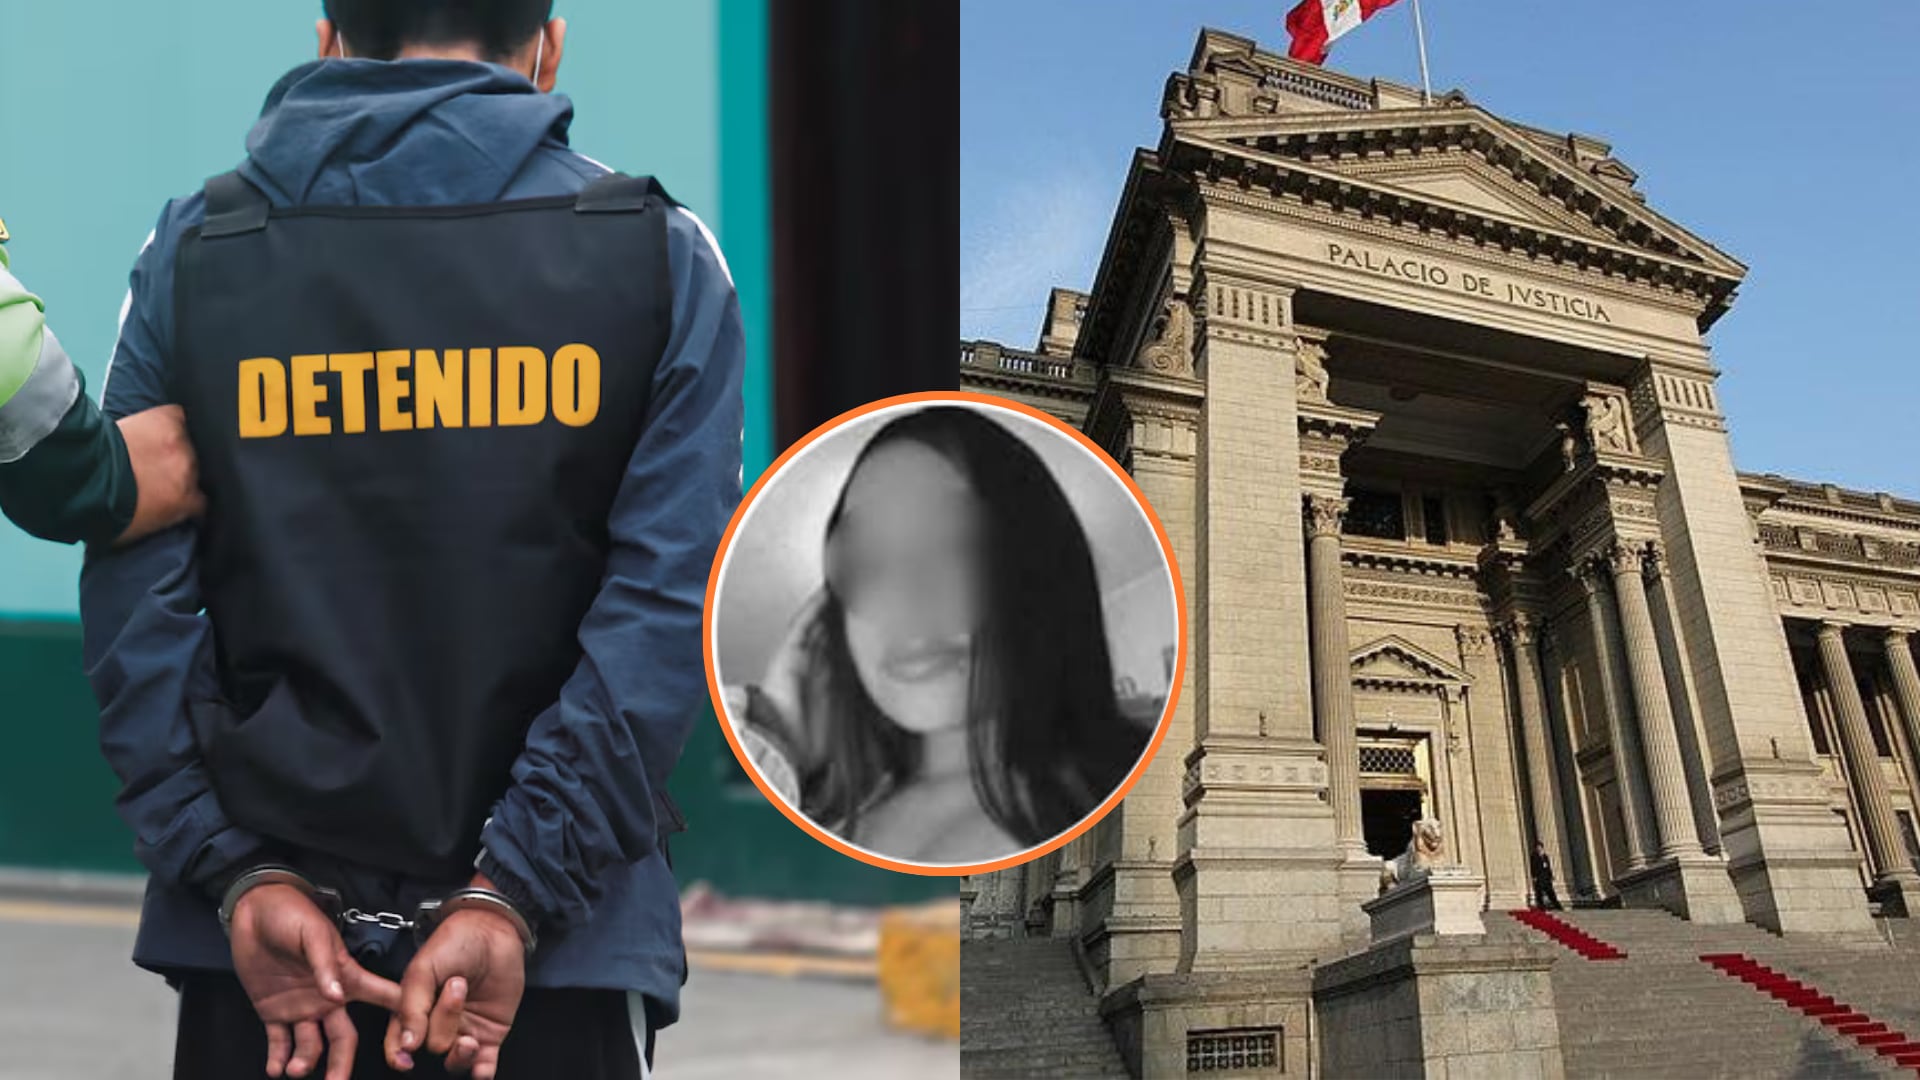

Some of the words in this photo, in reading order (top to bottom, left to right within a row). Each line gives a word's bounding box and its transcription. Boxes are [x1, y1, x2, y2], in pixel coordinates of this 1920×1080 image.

[1328, 243, 1449, 285] PALACIO
[1462, 272, 1494, 297] DE
[238, 343, 601, 439] DETENIDO
